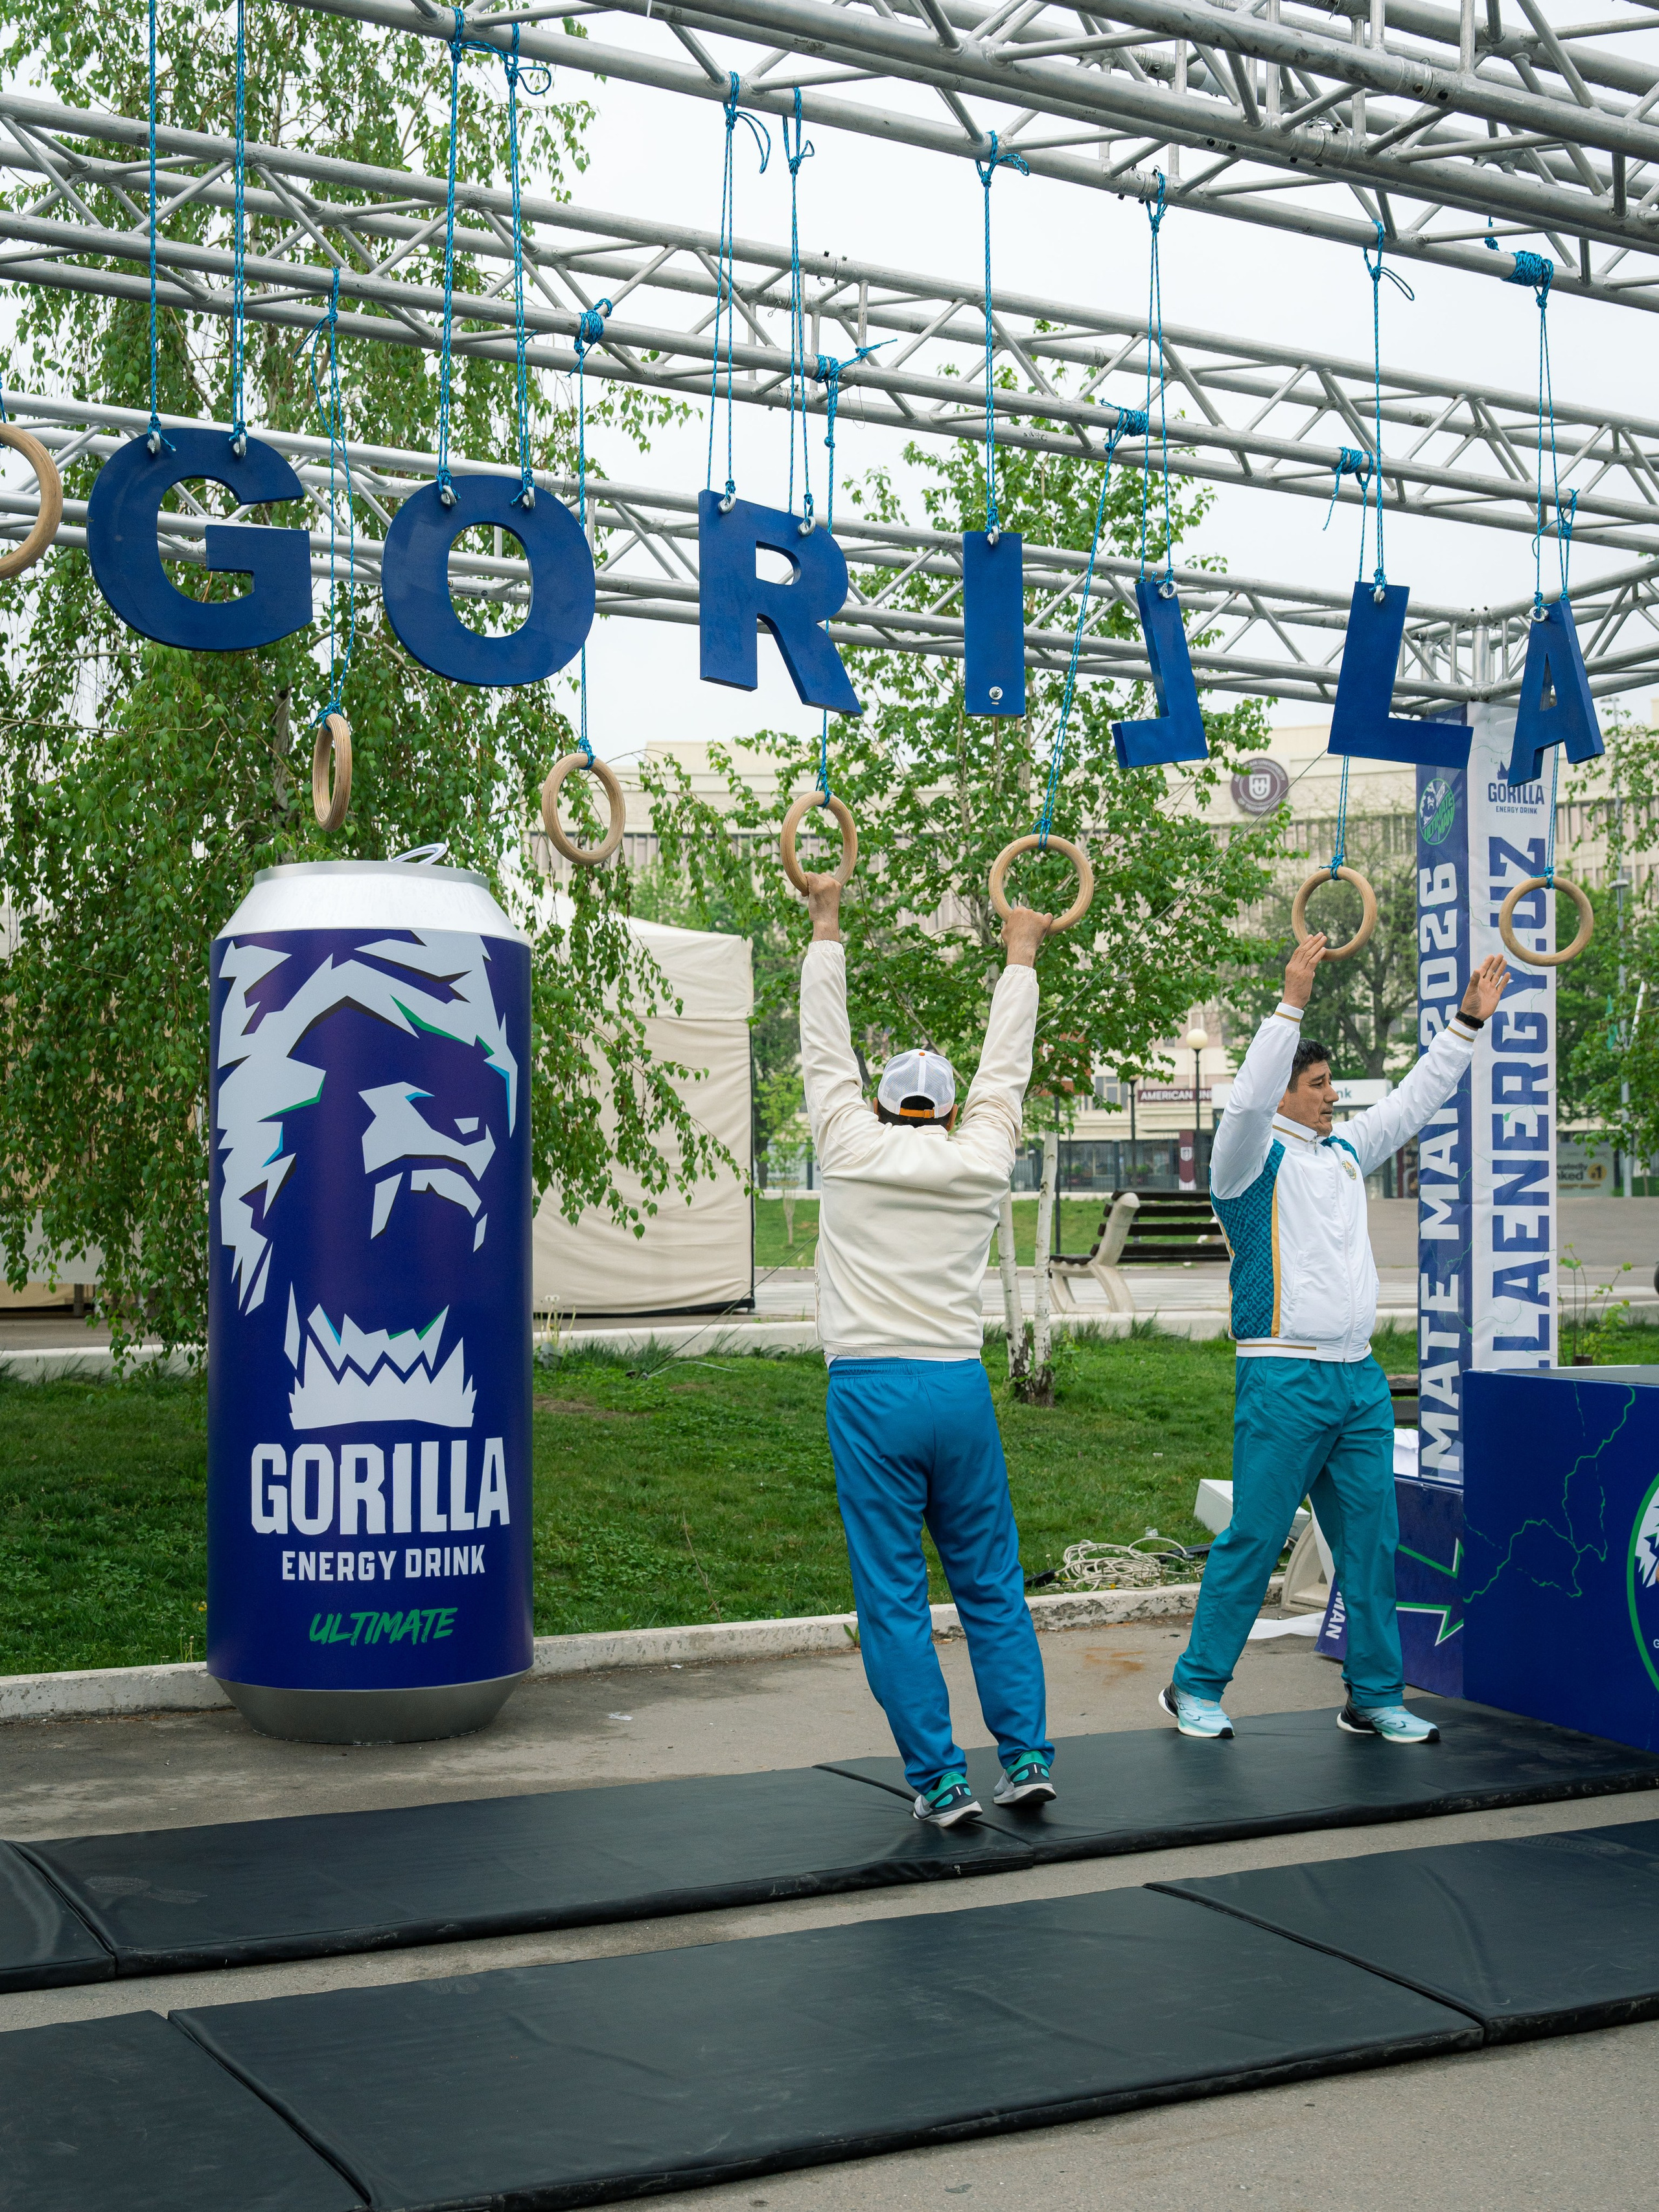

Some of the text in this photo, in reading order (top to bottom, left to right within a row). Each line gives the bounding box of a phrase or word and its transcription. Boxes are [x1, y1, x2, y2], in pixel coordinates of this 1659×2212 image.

[1488, 782, 1545, 805] GORILLA
[1496, 806, 1519, 814] ENERGY
[1419, 862, 1458, 1047] 2026
[1140, 1089, 1212, 1101] AMERICAN UN
[1489, 836, 1551, 1368] LAENERGY.UZ
[250, 1436, 511, 1535] GORILLA
[282, 1544, 485, 1581] ENERGY DRINK
[308, 1607, 458, 1646] ULTIMATE
